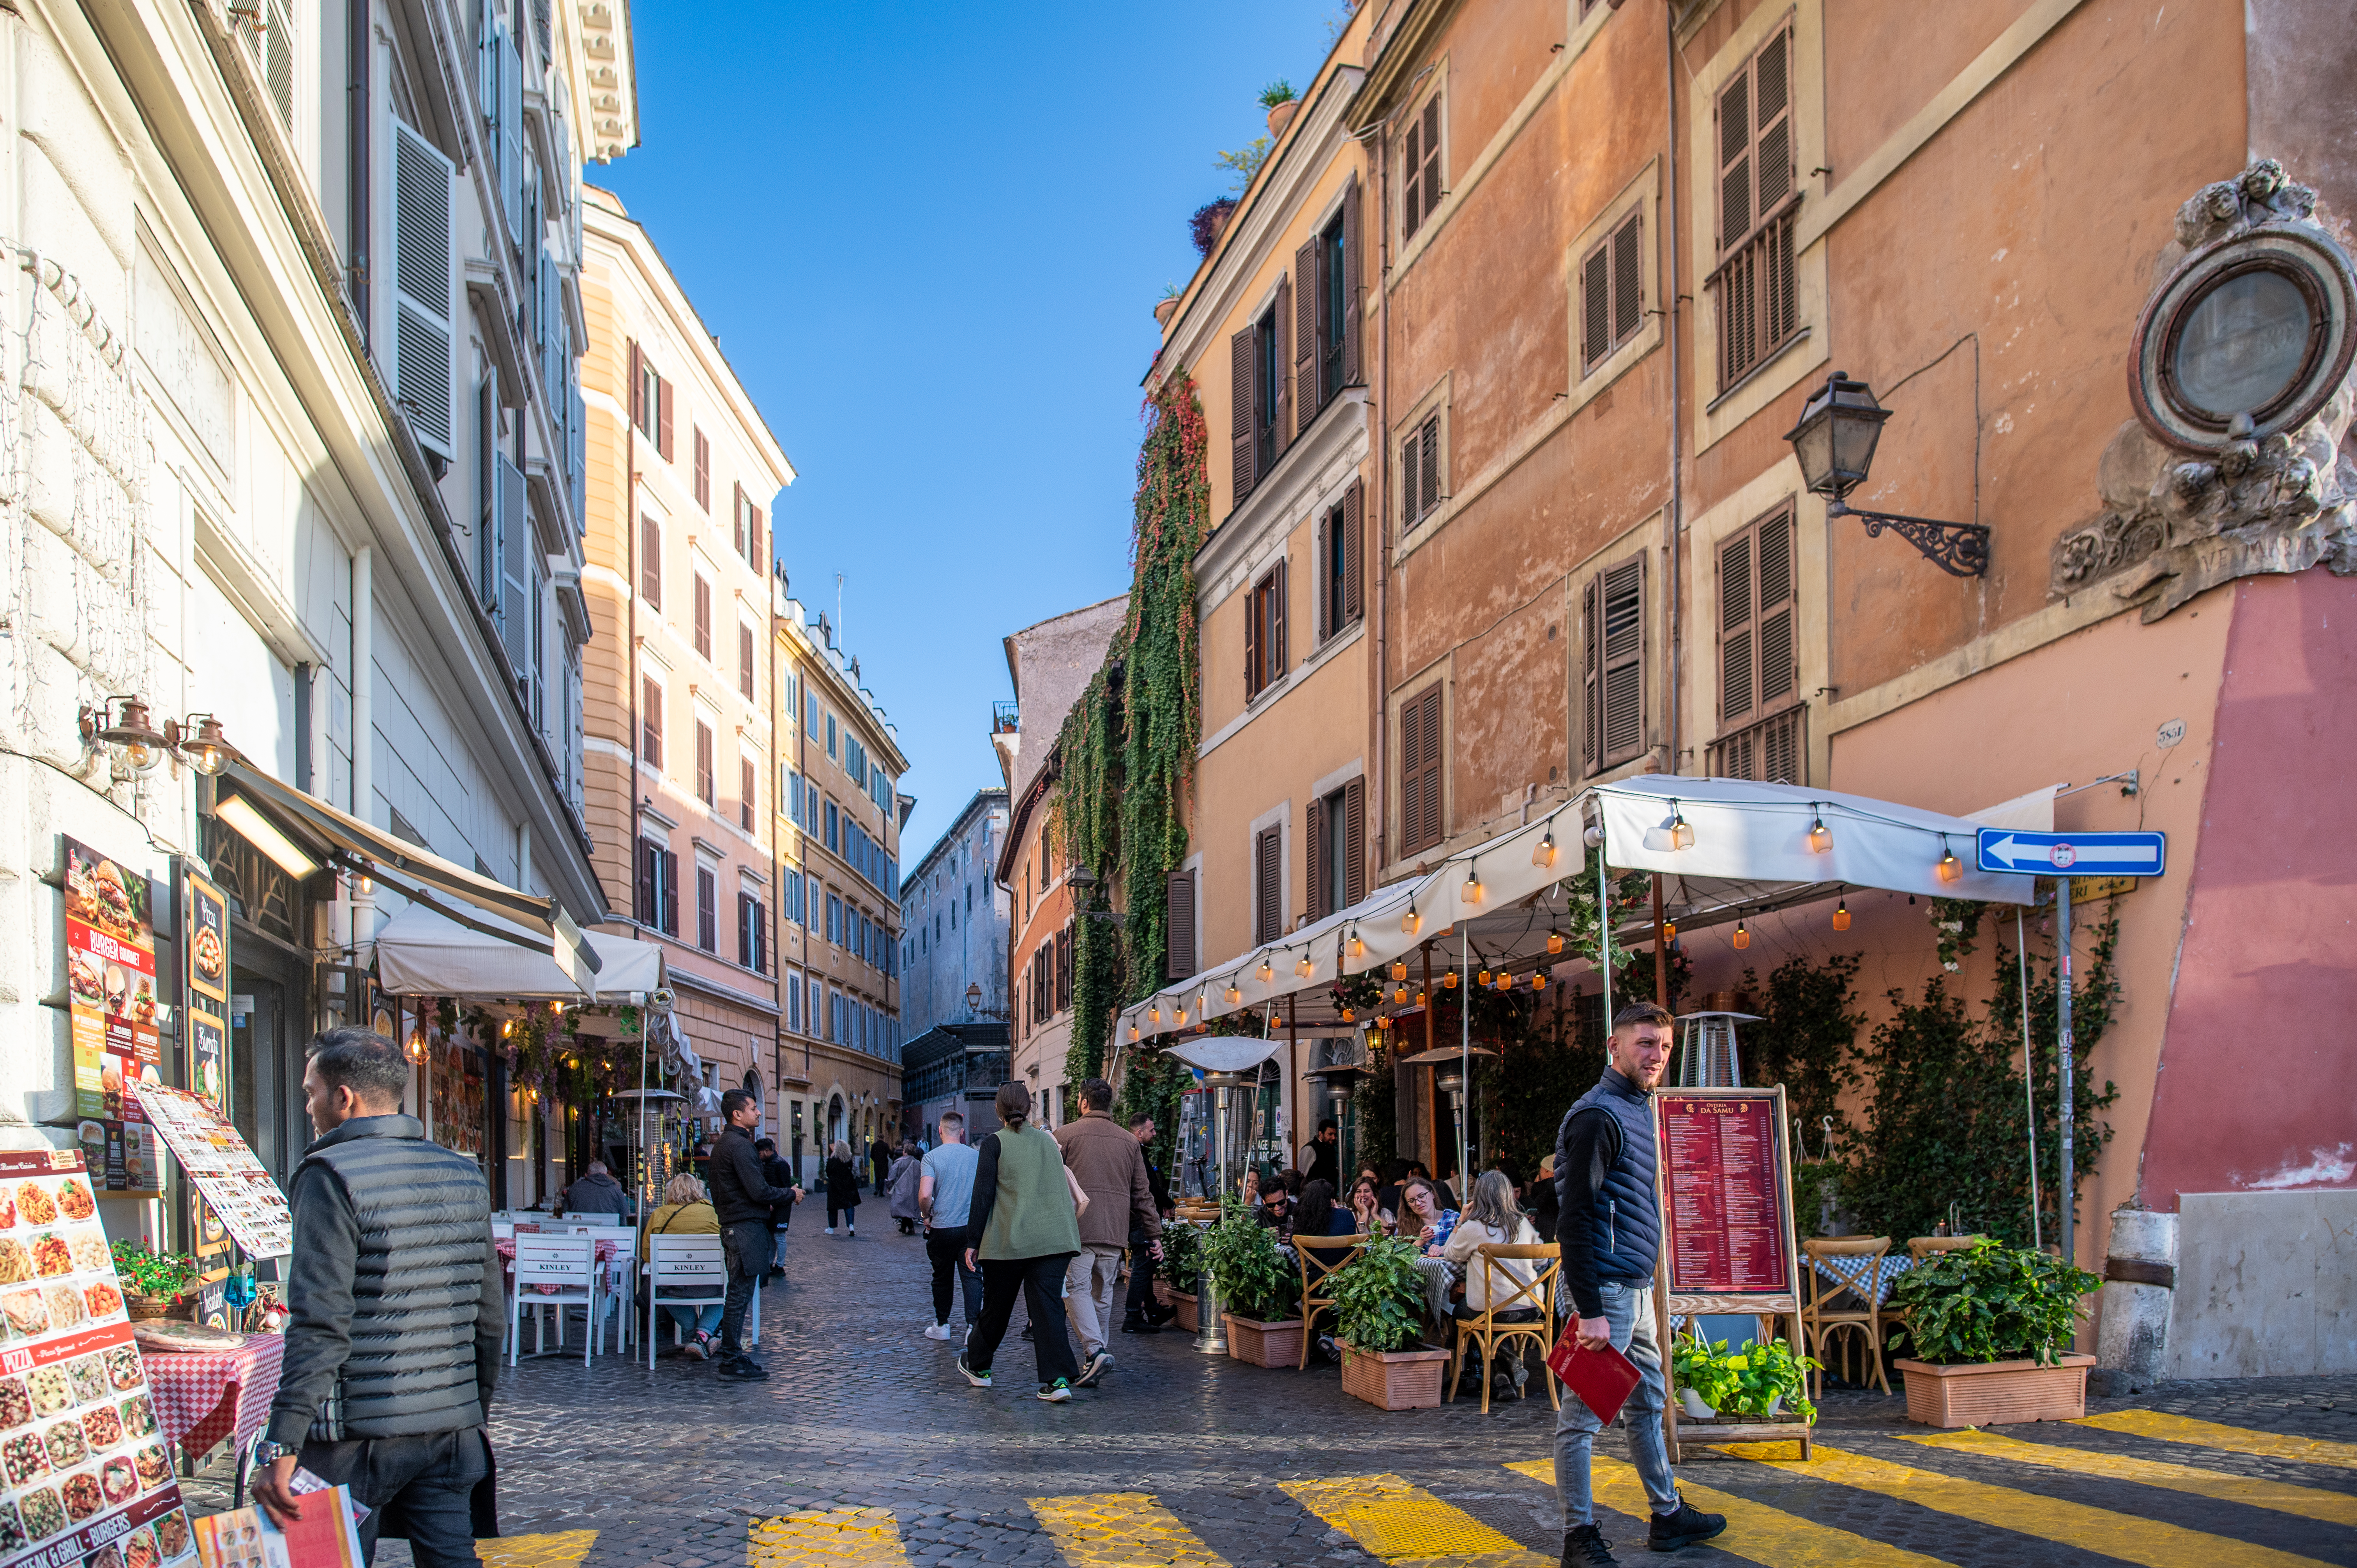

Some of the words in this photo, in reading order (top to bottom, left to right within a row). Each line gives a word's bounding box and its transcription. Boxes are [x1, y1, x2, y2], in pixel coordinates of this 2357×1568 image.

[201, 896, 217, 928] Pizza
[90, 930, 119, 961] BURGER
[119, 946, 140, 967] GOURMET
[198, 1026, 219, 1055] Burrata
[1, 1162, 19, 1171] Roman
[19, 1162, 37, 1170] Cuisine
[204, 1286, 223, 1314] Insalate
[2, 1348, 35, 1373] PIZZA
[48, 1547, 61, 1568] &
[57, 1534, 87, 1563] GRILL
[88, 1512, 131, 1547] BURGERS
